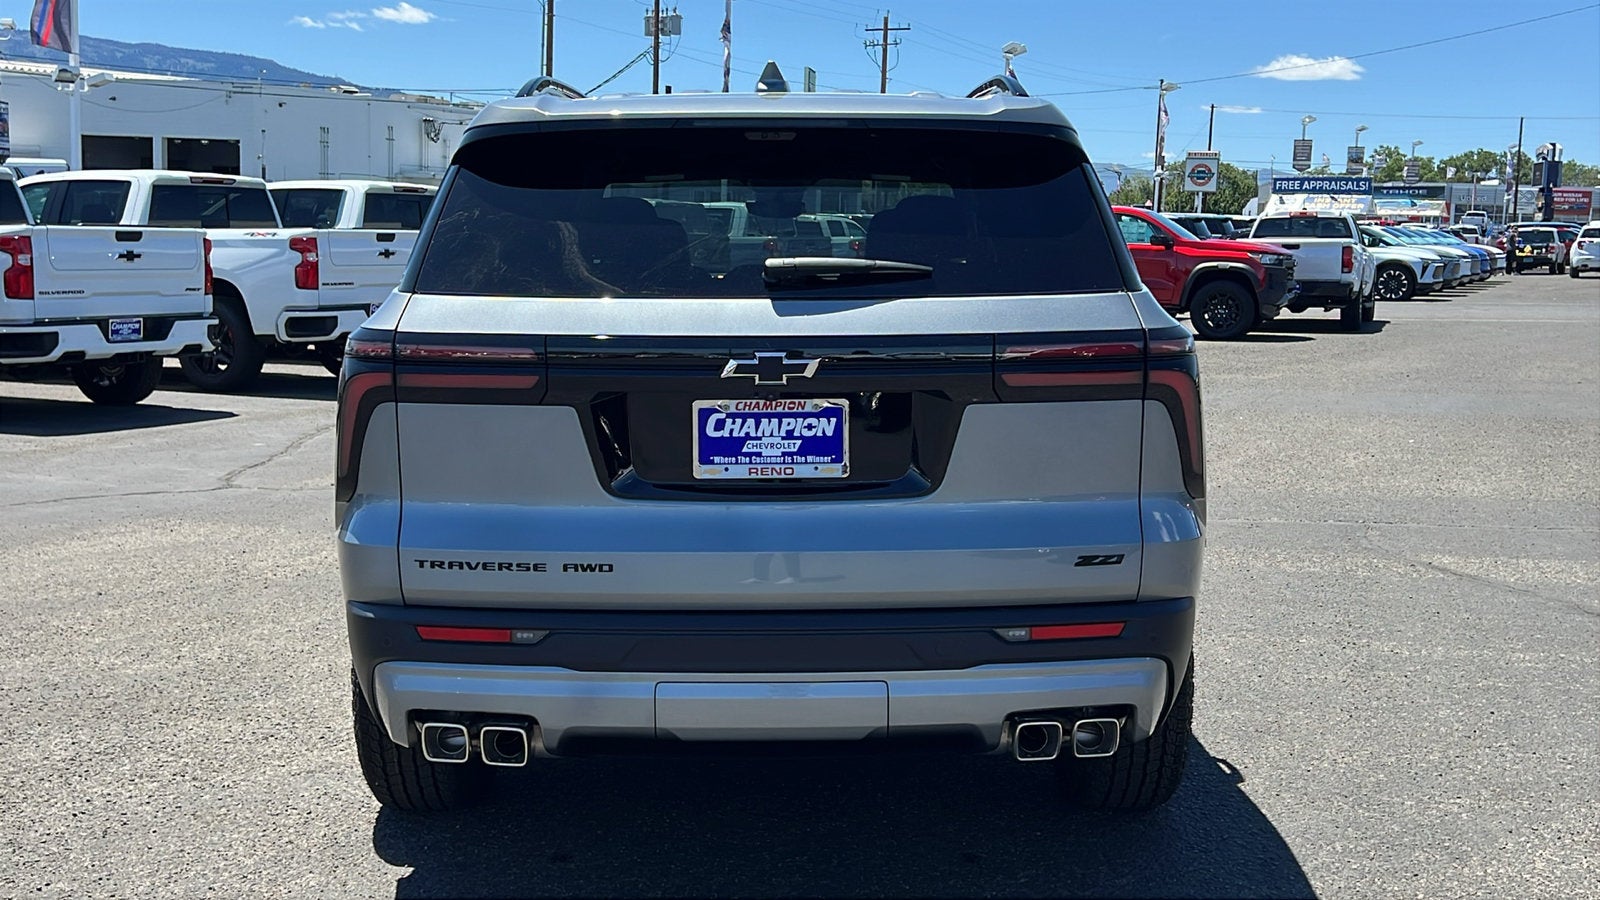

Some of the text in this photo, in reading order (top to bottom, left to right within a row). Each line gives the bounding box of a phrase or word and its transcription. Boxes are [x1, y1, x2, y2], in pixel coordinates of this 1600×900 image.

[1276, 180, 1369, 191] FREE APPRAISALS!
[111, 322, 140, 330] CHAMPION
[735, 400, 807, 411] CHAMPION
[705, 412, 837, 438] CHAMPION
[746, 441, 798, 450] CHEVROLET
[737, 456, 750, 464] The
[751, 456, 784, 464] Customer
[793, 455, 806, 463] The
[748, 466, 795, 476] RENO
[414, 559, 614, 573] TRAVERSE AWD
[1074, 554, 1125, 567] Z71
